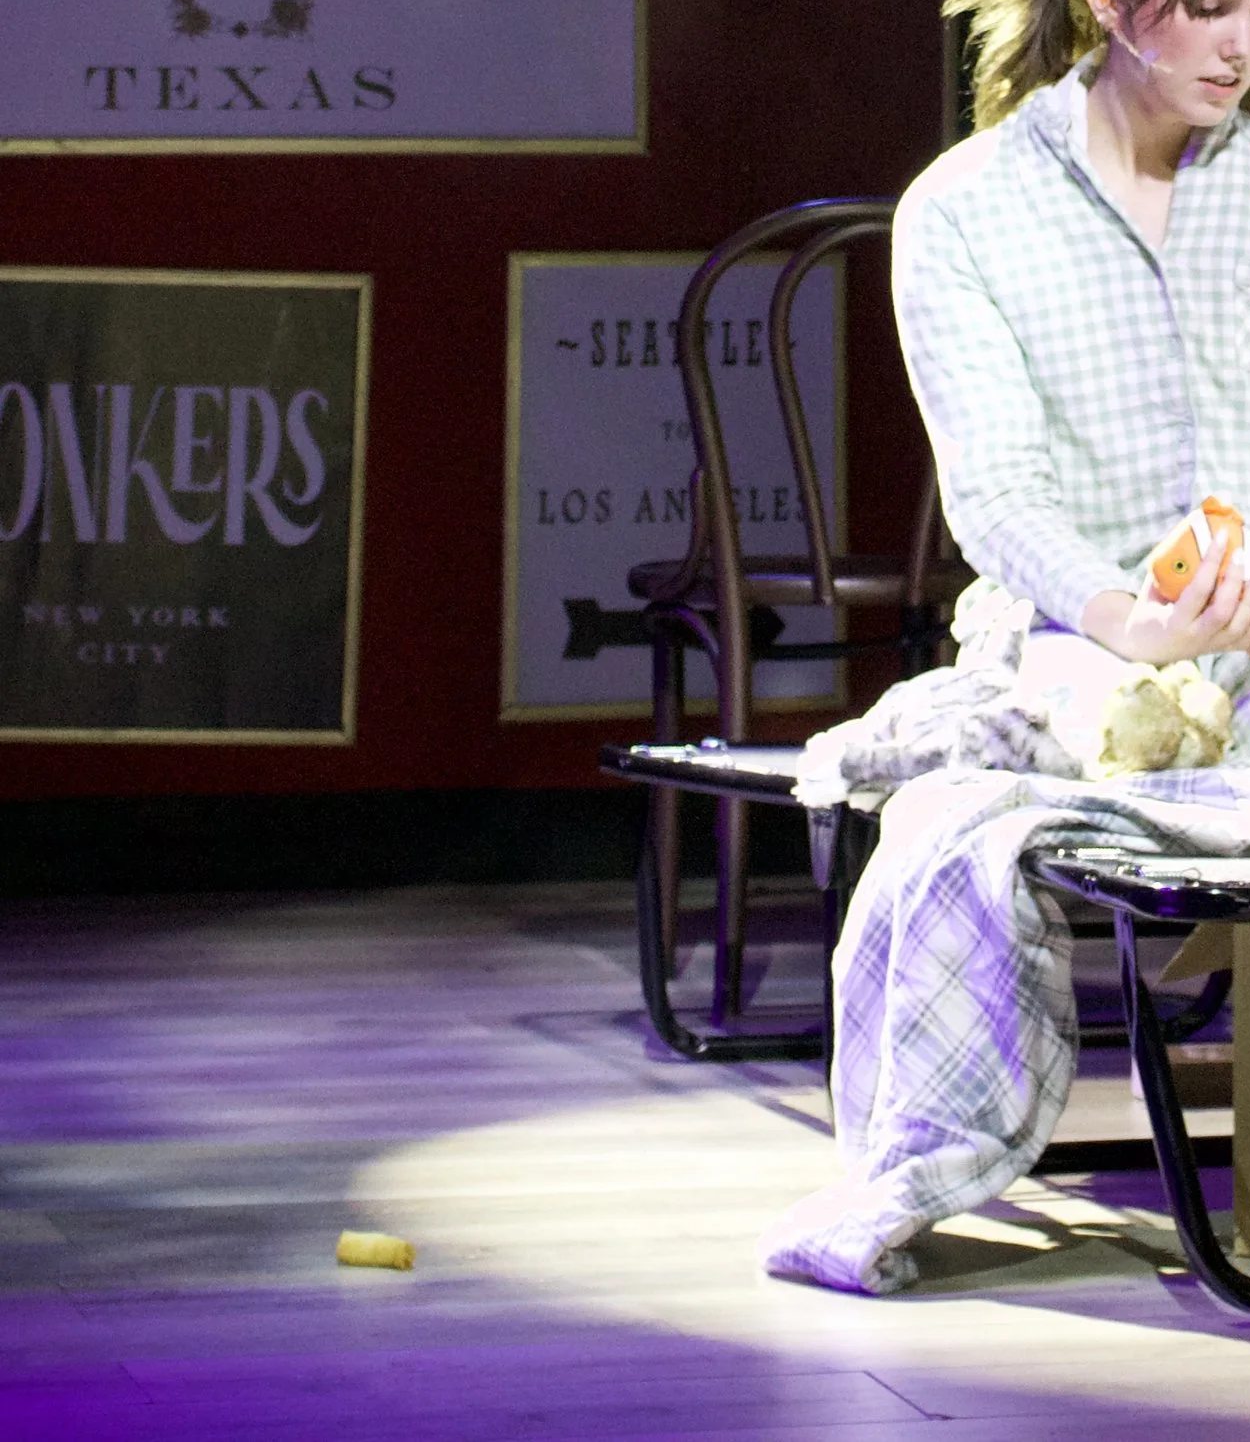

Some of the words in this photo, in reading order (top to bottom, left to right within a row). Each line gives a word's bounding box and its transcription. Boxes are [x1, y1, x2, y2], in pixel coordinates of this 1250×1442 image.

[86, 66, 396, 112] TEXAS
[591, 320, 763, 367] SEALE
[0, 382, 329, 546] ONKERS
[538, 490, 613, 525] LOS
[634, 490, 808, 526] ANELE
[24, 604, 101, 624] NEW
[127, 605, 229, 628] YORK
[77, 643, 170, 665] CITY
